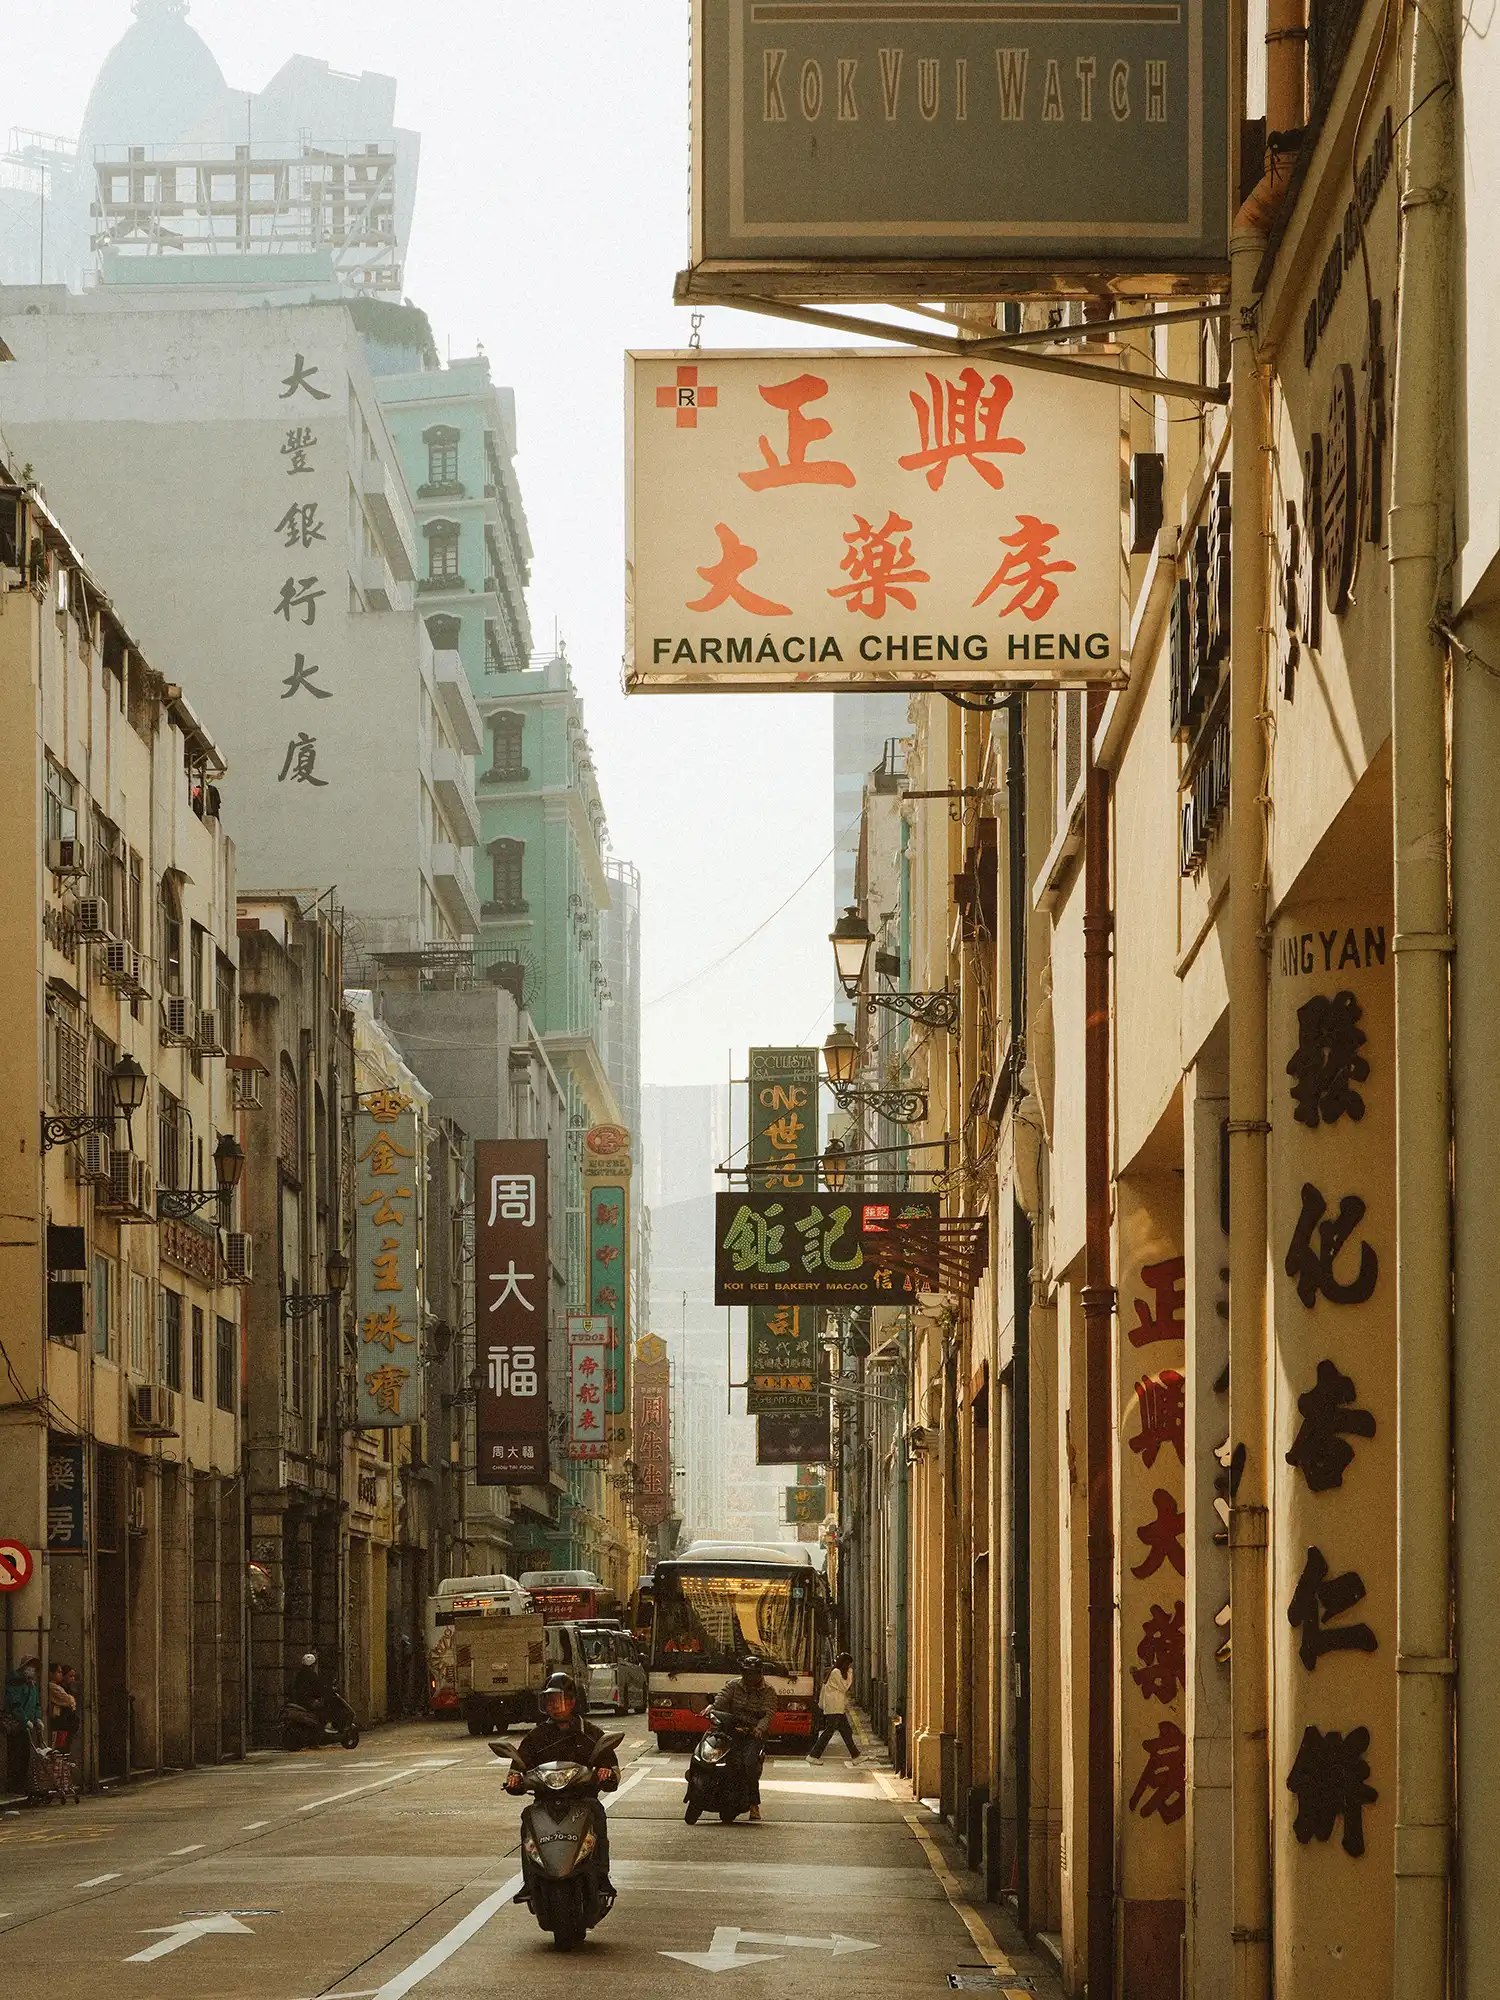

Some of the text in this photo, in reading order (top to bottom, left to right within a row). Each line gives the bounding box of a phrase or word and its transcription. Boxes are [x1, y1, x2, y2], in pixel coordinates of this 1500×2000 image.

[762, 48, 1168, 122] KOK VUI WATCH
[738, 367, 1026, 492] 正興
[685, 509, 1078, 622] 大藥房
[652, 632, 1111, 666] FARMÁCIA CHENG HENG
[753, 1055, 813, 1069] OCULISTA
[722, 1202, 864, 1274] 鉅記
[359, 1130, 416, 1417] 金公主珠寶
[487, 1174, 538, 1397] 周大福
[571, 1334, 606, 1342] TUDOR
[492, 1446, 535, 1459] 周大福
[607, 1428, 625, 1442] 28
[640, 1396, 664, 1495] 周生生
[778, 1688, 796, 1696] 6003
[539, 1833, 578, 1844] MN-70-30
